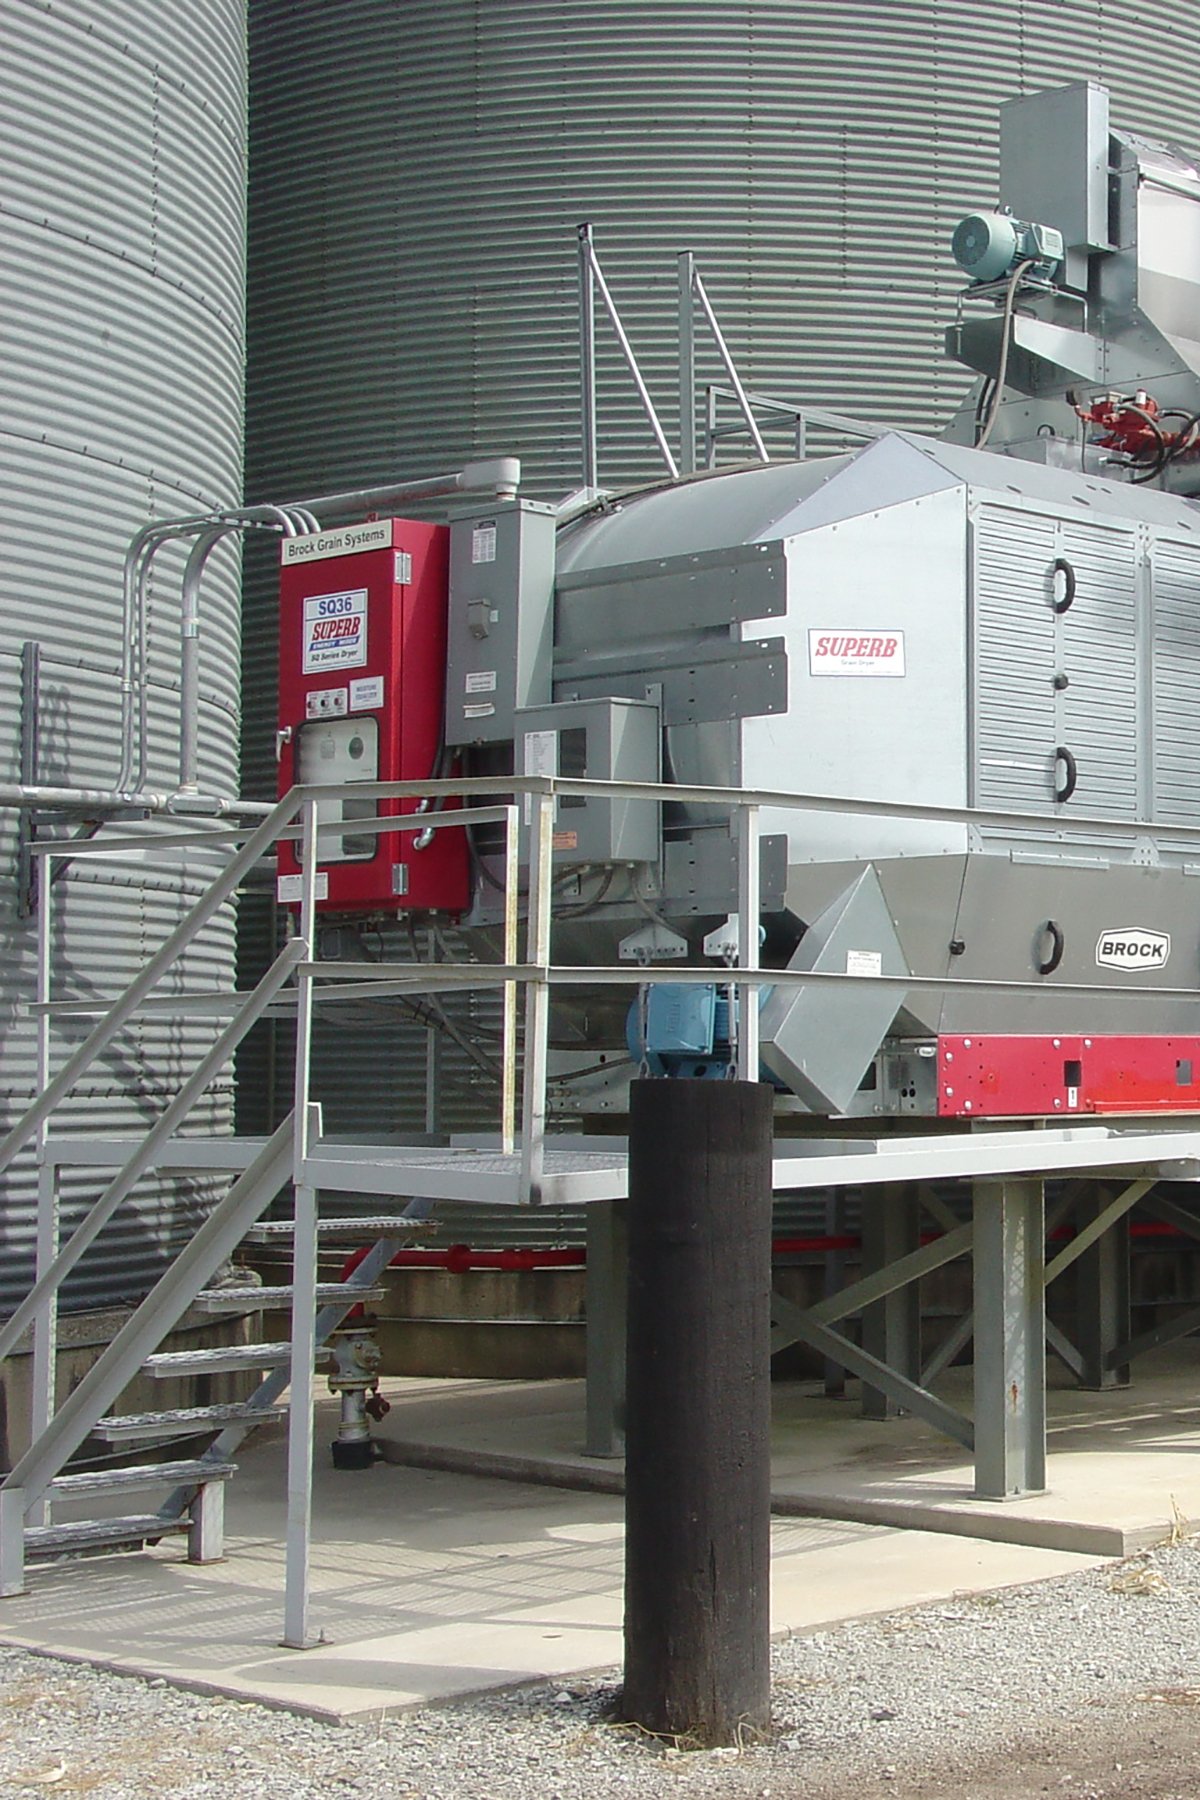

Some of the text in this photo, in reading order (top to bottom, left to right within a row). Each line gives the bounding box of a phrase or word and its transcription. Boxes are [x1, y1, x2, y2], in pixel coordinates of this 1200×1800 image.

[288, 529, 385, 557] Brock Grain Systems
[318, 597, 353, 615] SQ36
[311, 616, 361, 641] SUPERB
[815, 637, 898, 657] SUPERB
[1102, 941, 1164, 958] BROCK
